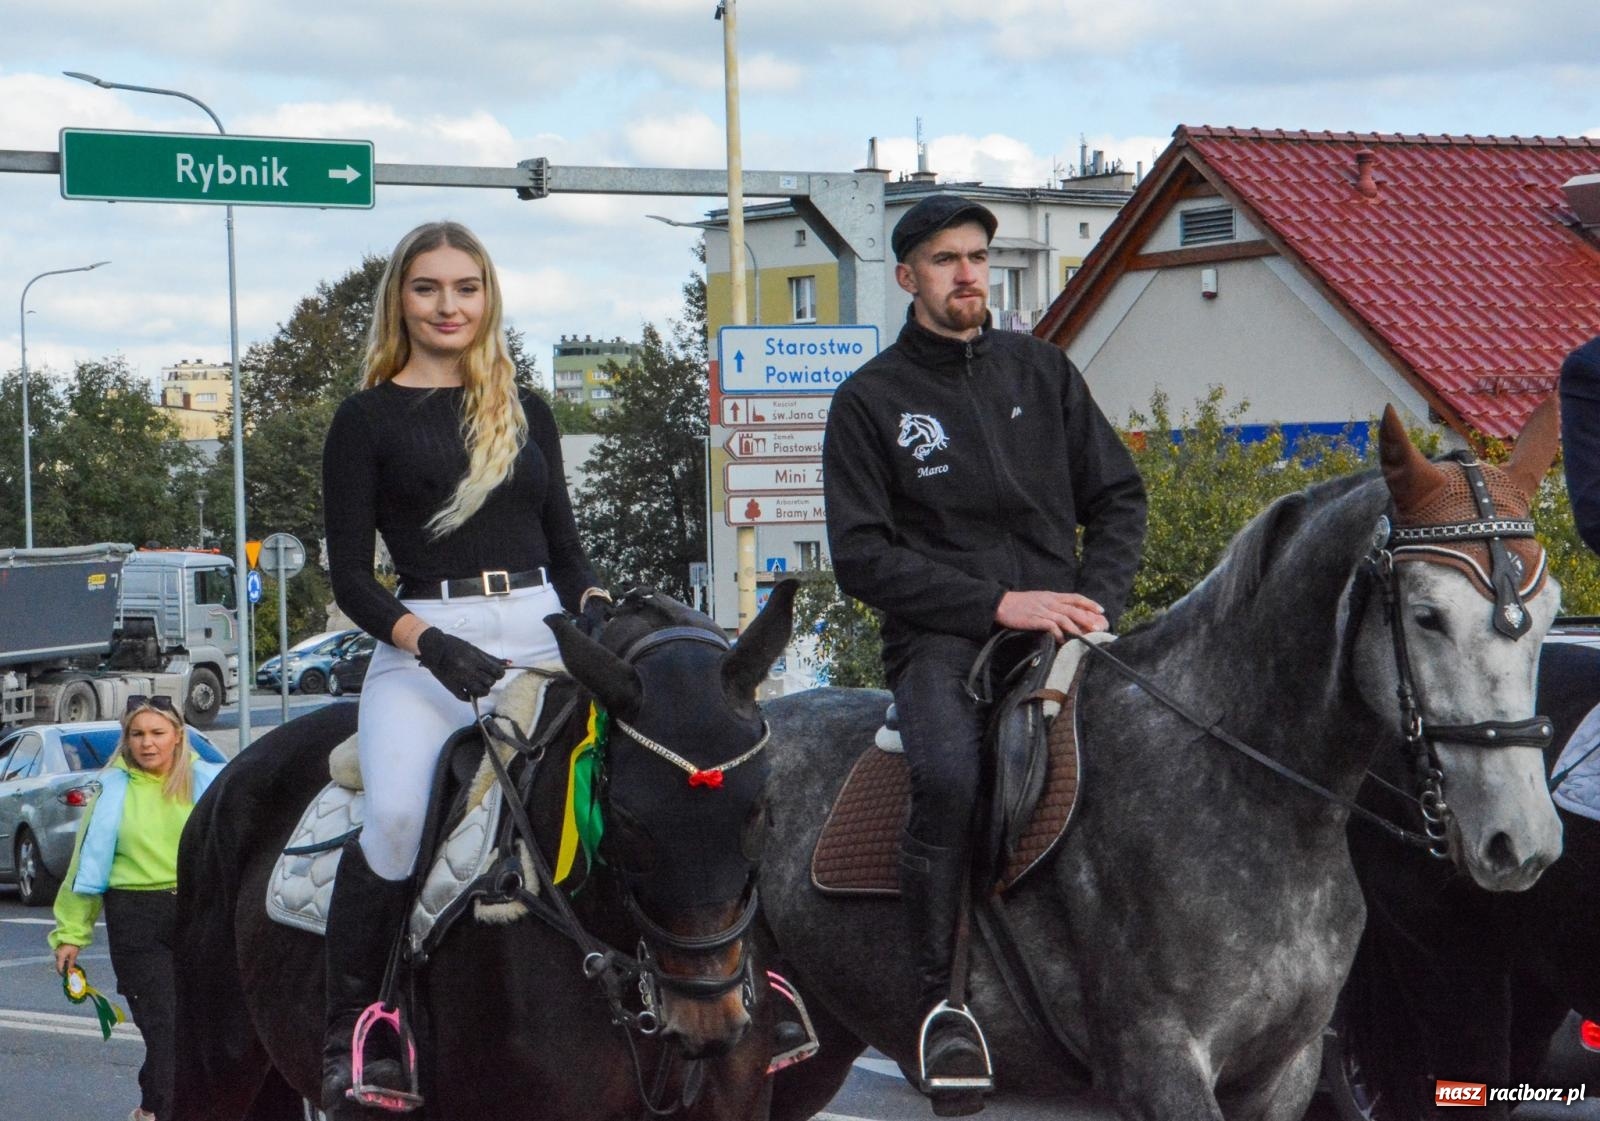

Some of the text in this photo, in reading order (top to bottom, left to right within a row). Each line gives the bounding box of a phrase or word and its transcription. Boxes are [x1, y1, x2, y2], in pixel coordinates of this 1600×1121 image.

[176, 152, 289, 193] Rybnik
[765, 337, 863, 356] Starostwo
[775, 469, 806, 484] Mini
[917, 464, 949, 479] Marco
[776, 508, 808, 521] Bramy
